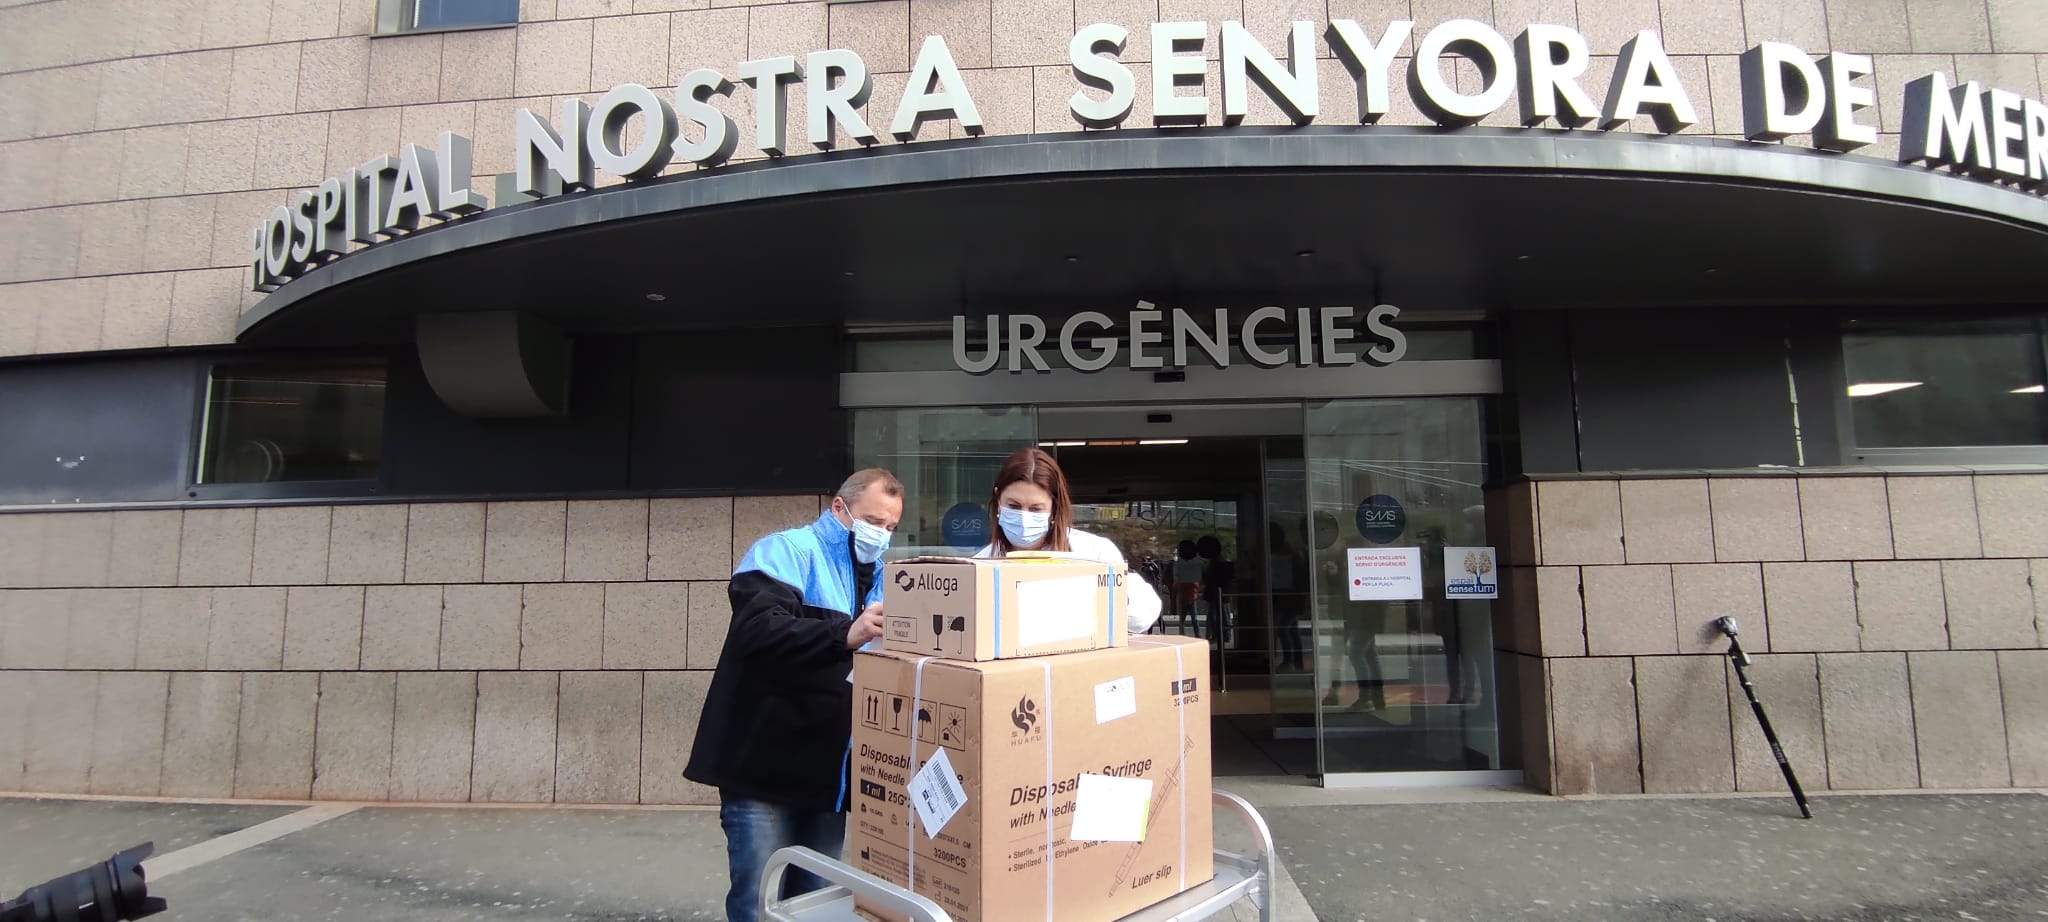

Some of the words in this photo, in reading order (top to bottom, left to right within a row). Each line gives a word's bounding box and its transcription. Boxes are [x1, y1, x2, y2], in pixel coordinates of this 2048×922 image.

[252, 131, 482, 292] HOSPITAL
[515, 35, 984, 200] NOSTRA
[1069, 19, 1697, 133] SENYORA
[1744, 41, 1877, 152] DE
[952, 300, 1407, 374] URGÈNCIES
[917, 573, 958, 597] Alloga
[860, 743, 913, 771] Disposabl
[860, 764, 876, 777] with
[877, 767, 905, 786] Needle
[1010, 811, 1035, 829] with
[933, 847, 967, 868] 3200PCS
[1132, 873, 1152, 890] Luer
[1156, 864, 1172, 880] slip
